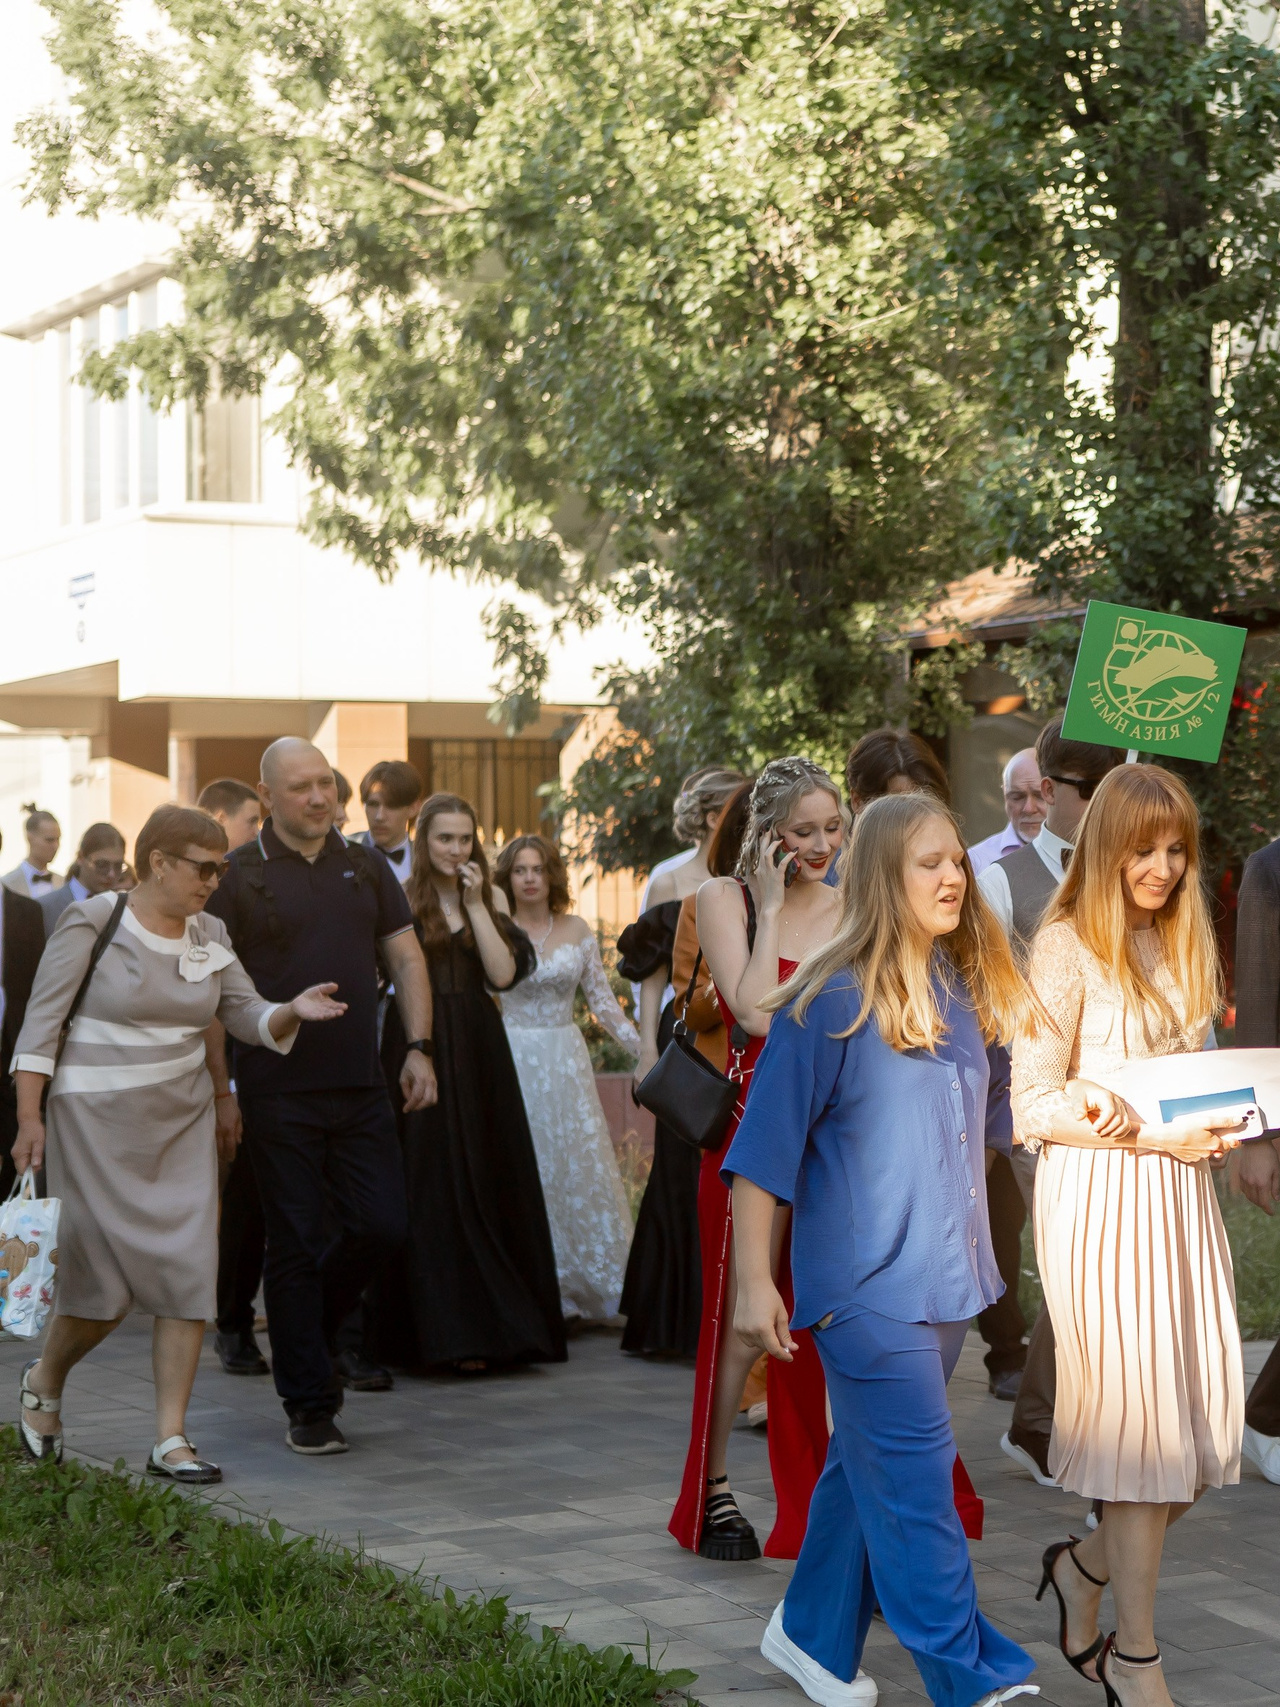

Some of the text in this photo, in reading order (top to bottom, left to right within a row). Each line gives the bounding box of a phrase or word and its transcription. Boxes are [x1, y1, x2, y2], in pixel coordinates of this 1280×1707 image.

[1087, 680, 1221, 741] ГИМНАЗИЯ № 12
